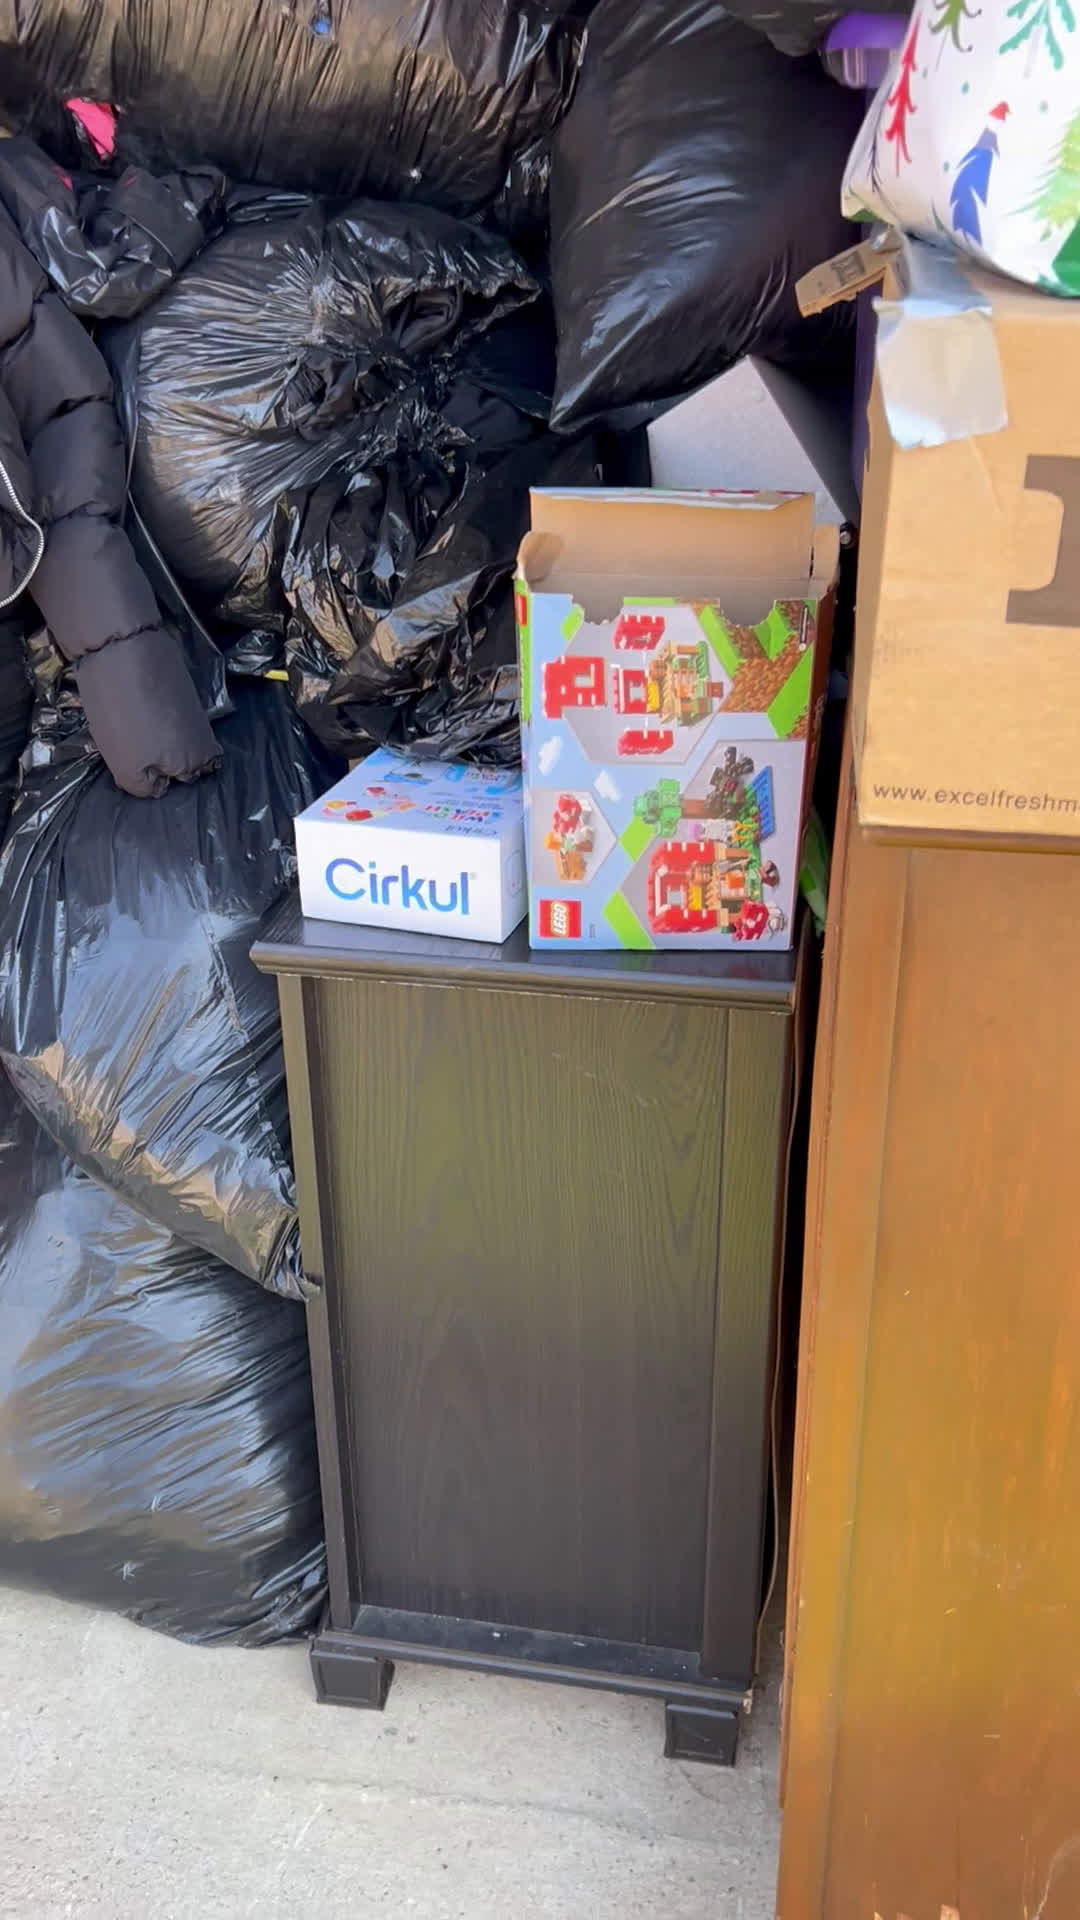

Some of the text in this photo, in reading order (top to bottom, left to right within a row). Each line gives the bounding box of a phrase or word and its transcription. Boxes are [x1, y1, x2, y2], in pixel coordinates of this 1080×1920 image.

[873, 783, 1080, 813] www.excelfreshm
[325, 857, 469, 914] Cirkul
[551, 901, 569, 937] LEGO
